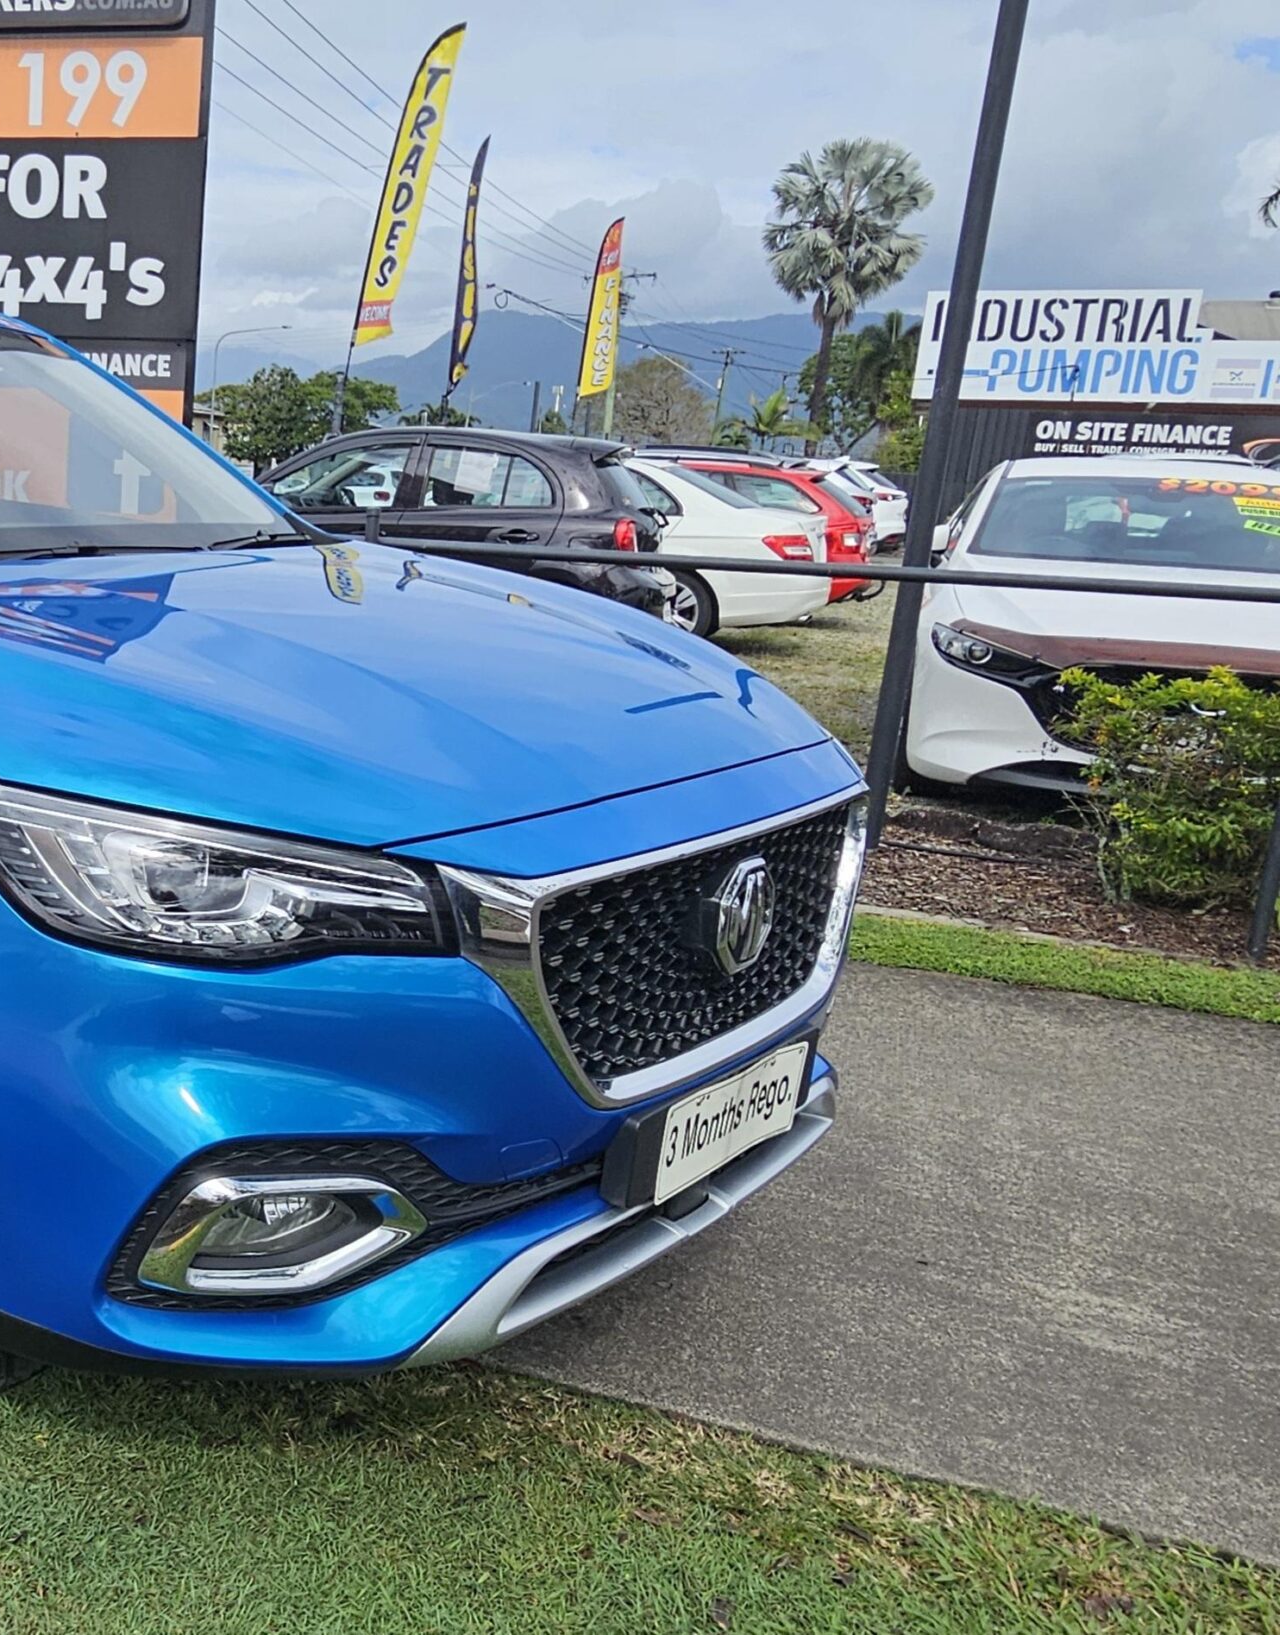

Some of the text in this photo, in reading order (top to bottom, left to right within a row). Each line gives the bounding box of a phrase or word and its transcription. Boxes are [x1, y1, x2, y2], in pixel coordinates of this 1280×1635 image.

[17, 50, 148, 127] 199
[374, 67, 451, 289] TRADES
[591, 276, 618, 387] FINANCE
[82, 352, 171, 378] NANCE
[986, 348, 1200, 395] PUMPING
[1034, 443, 1056, 452] BUY
[1060, 444, 1085, 454] SELL
[1035, 420, 1233, 446] ON SITE FINANCE
[665, 1125, 679, 1168] 3
[680, 1096, 743, 1160] Months
